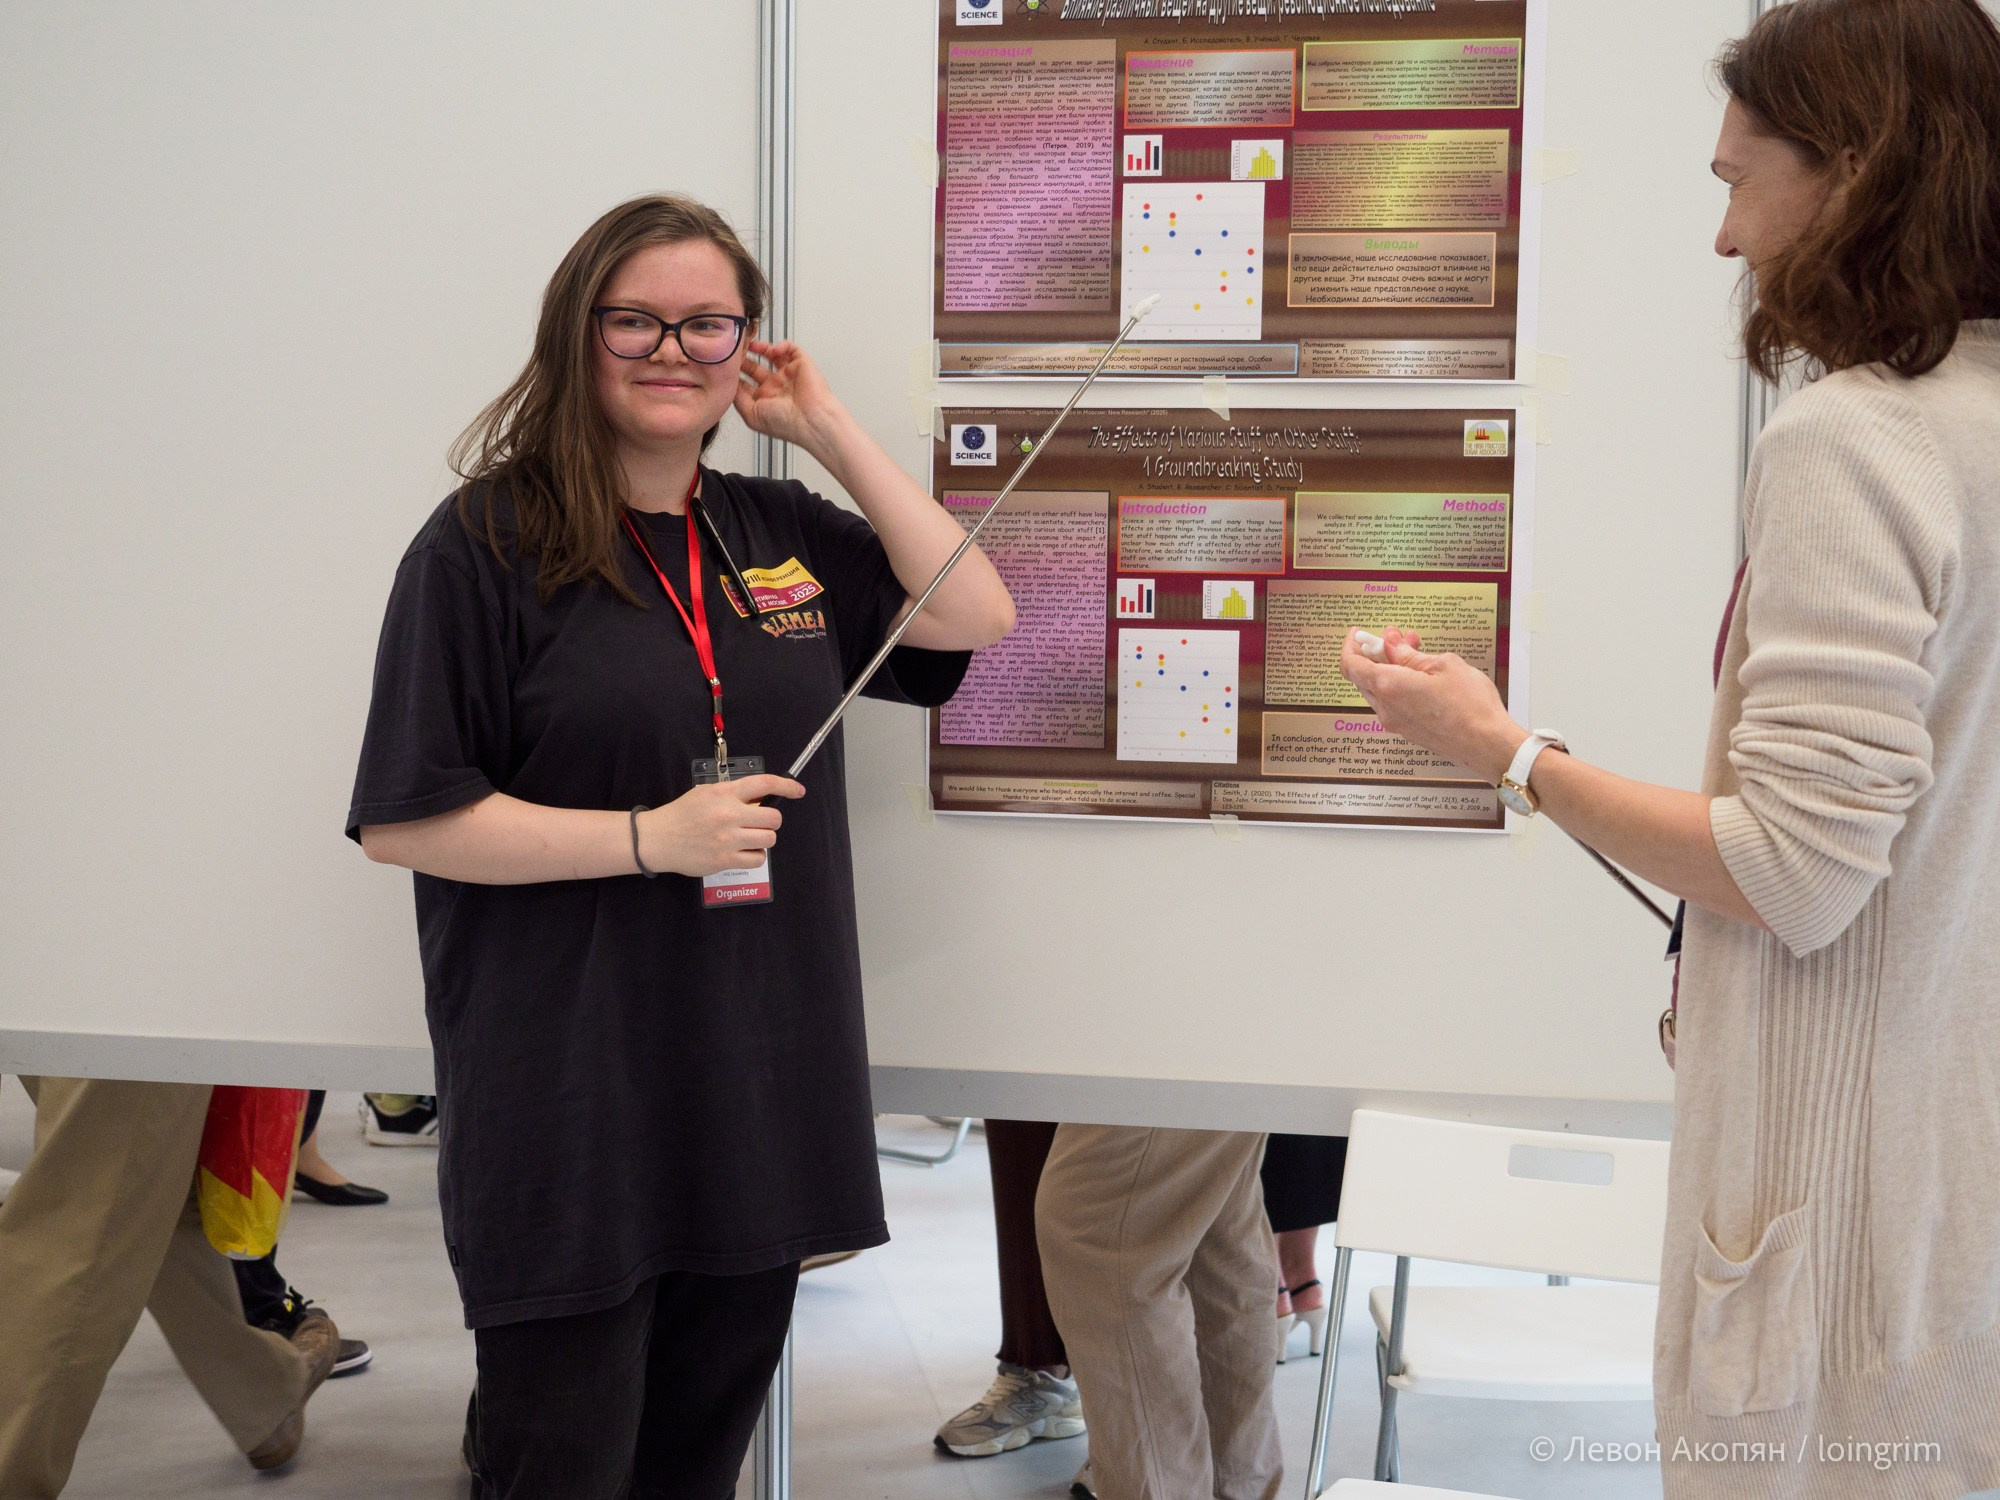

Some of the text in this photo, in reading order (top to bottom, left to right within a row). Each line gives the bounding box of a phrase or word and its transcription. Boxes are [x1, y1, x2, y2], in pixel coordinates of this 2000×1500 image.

[960, 11, 998, 20] SCIENCE
[950, 46, 1034, 58] Аннотация
[1462, 44, 1518, 54] Методы
[1130, 56, 1194, 68] Введение
[1373, 132, 1428, 142] Результаты
[1364, 239, 1420, 250] Выводы
[1332, 264, 1393, 273] действительно
[1305, 294, 1359, 304] Необходимы
[1362, 294, 1412, 304] дальнейшие
[1088, 425, 1110, 448] The
[1112, 425, 1157, 452] Effects
[1160, 425, 1176, 452] of
[1179, 426, 1226, 448] Various
[1229, 426, 1261, 454] Stuff
[1266, 432, 1281, 448] on
[1284, 426, 1319, 448] Other
[955, 452, 992, 460] SCIENCE
[1155, 456, 1261, 483] Groundbreaking
[1263, 456, 1303, 483] Study
[944, 495, 996, 506] Abstrac
[1442, 500, 1506, 512] Methods
[1121, 502, 1208, 514] Introduction
[790, 584, 816, 602] 2025
[1364, 584, 1398, 592] Results
[1334, 719, 1385, 732] Conclu
[1282, 734, 1325, 744] conclusion,
[1341, 735, 1364, 745] study
[1382, 746, 1413, 756] findings
[1308, 755, 1336, 765] change
[716, 887, 758, 900] Organizer
